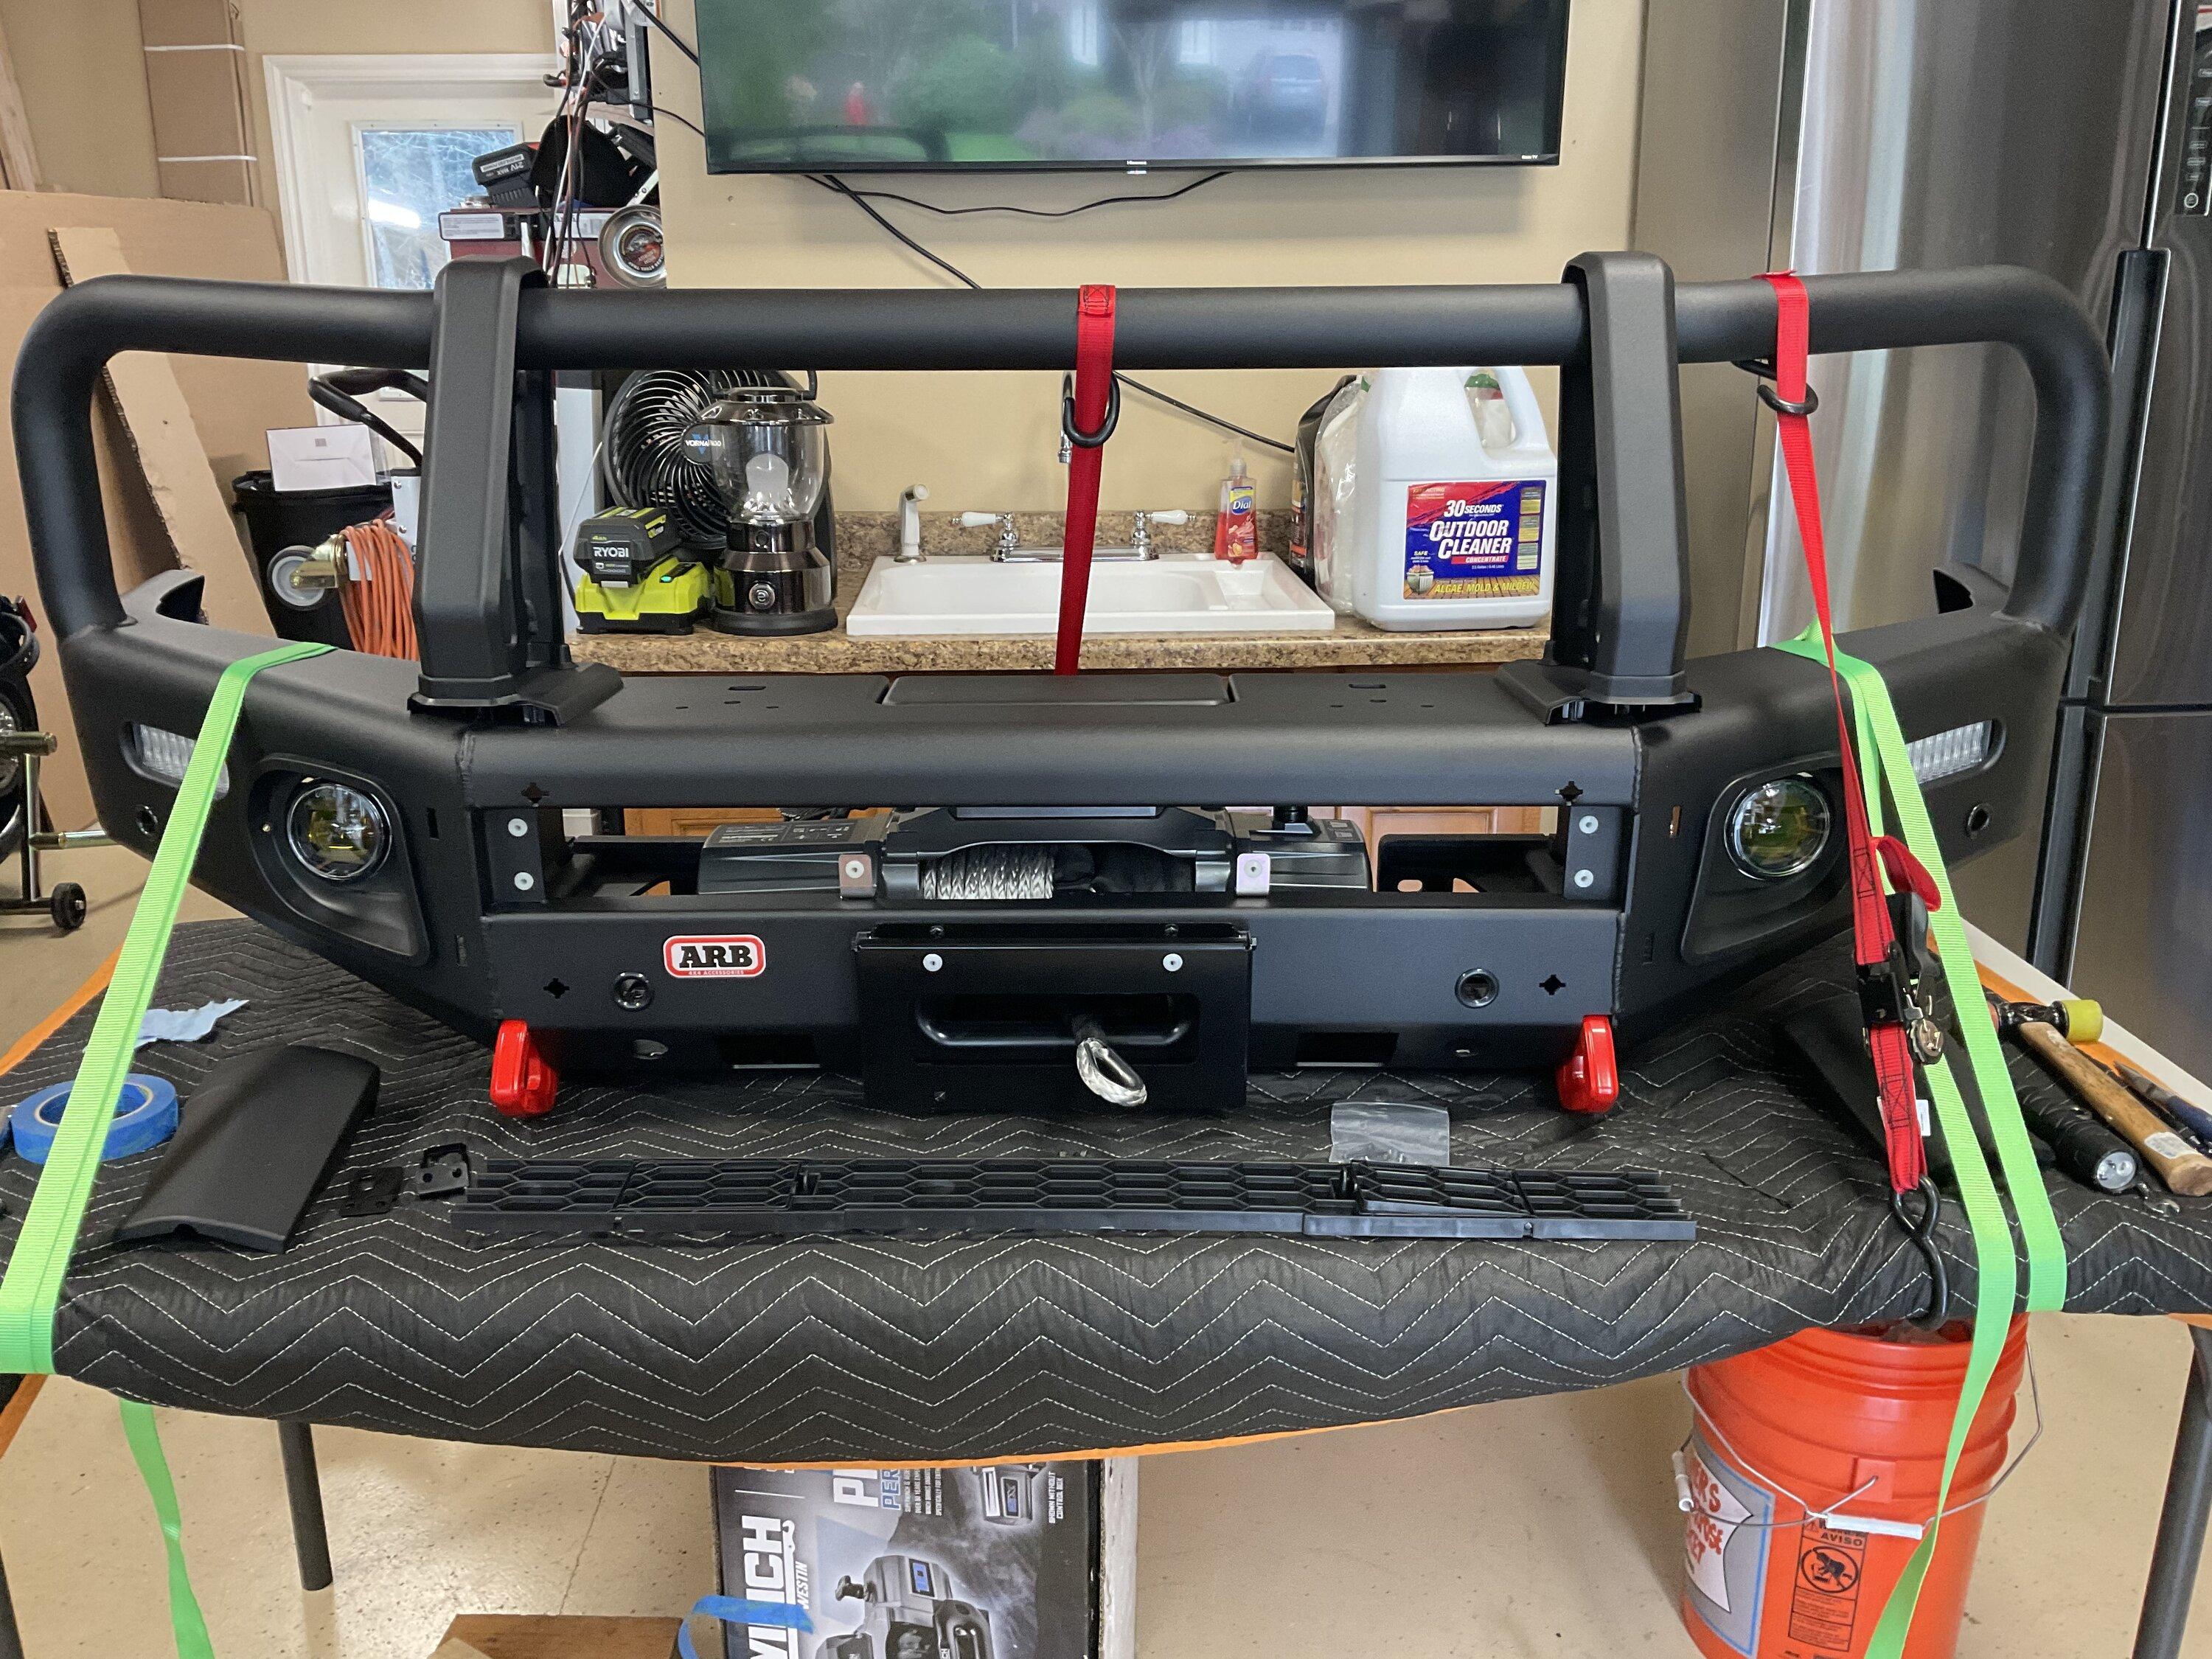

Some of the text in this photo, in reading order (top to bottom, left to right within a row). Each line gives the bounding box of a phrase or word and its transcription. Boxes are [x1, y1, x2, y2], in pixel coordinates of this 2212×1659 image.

[1232, 500, 1252, 510] Dial
[1444, 499, 1502, 518] 30 SECONDS
[1429, 520, 1509, 542] OUTDOOR
[592, 546, 630, 558] RYOBI
[1438, 537, 1513, 559] CLEANER
[1465, 555, 1507, 564] CONCENTRATE
[1467, 582, 1491, 592] MOLD
[1492, 582, 1500, 591] &
[1501, 580, 1535, 591] MILDEW
[679, 945, 753, 968] ARB
[1820, 1531, 1863, 1547] AVISO
